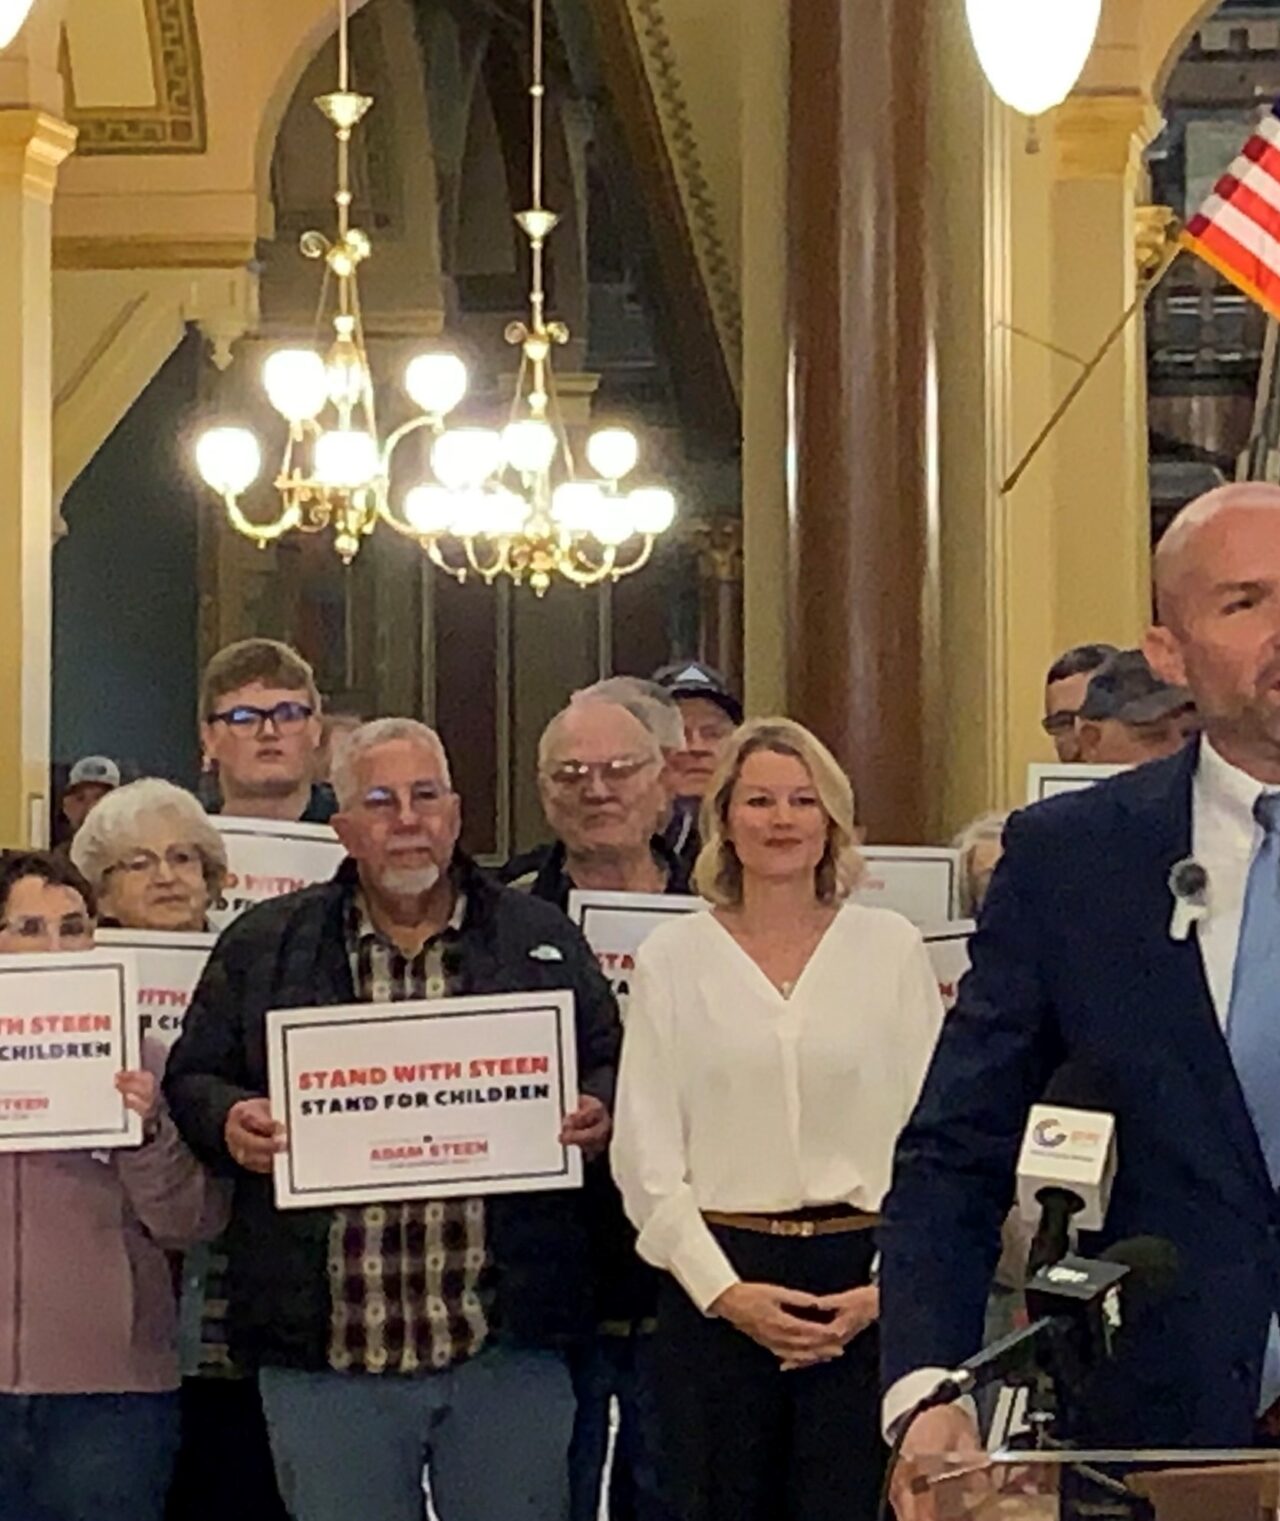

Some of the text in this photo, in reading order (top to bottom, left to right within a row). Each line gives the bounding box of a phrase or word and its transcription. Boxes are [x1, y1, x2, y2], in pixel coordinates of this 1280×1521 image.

[138, 989, 186, 1006] ITH
[30, 1014, 111, 1035] STEEN
[0, 1042, 111, 1061] CHILDREN
[298, 1056, 549, 1090] STAND WITH STEEN
[301, 1084, 549, 1116] STAND FOR CHILDREN
[370, 1140, 489, 1162] ADAM STEEN
